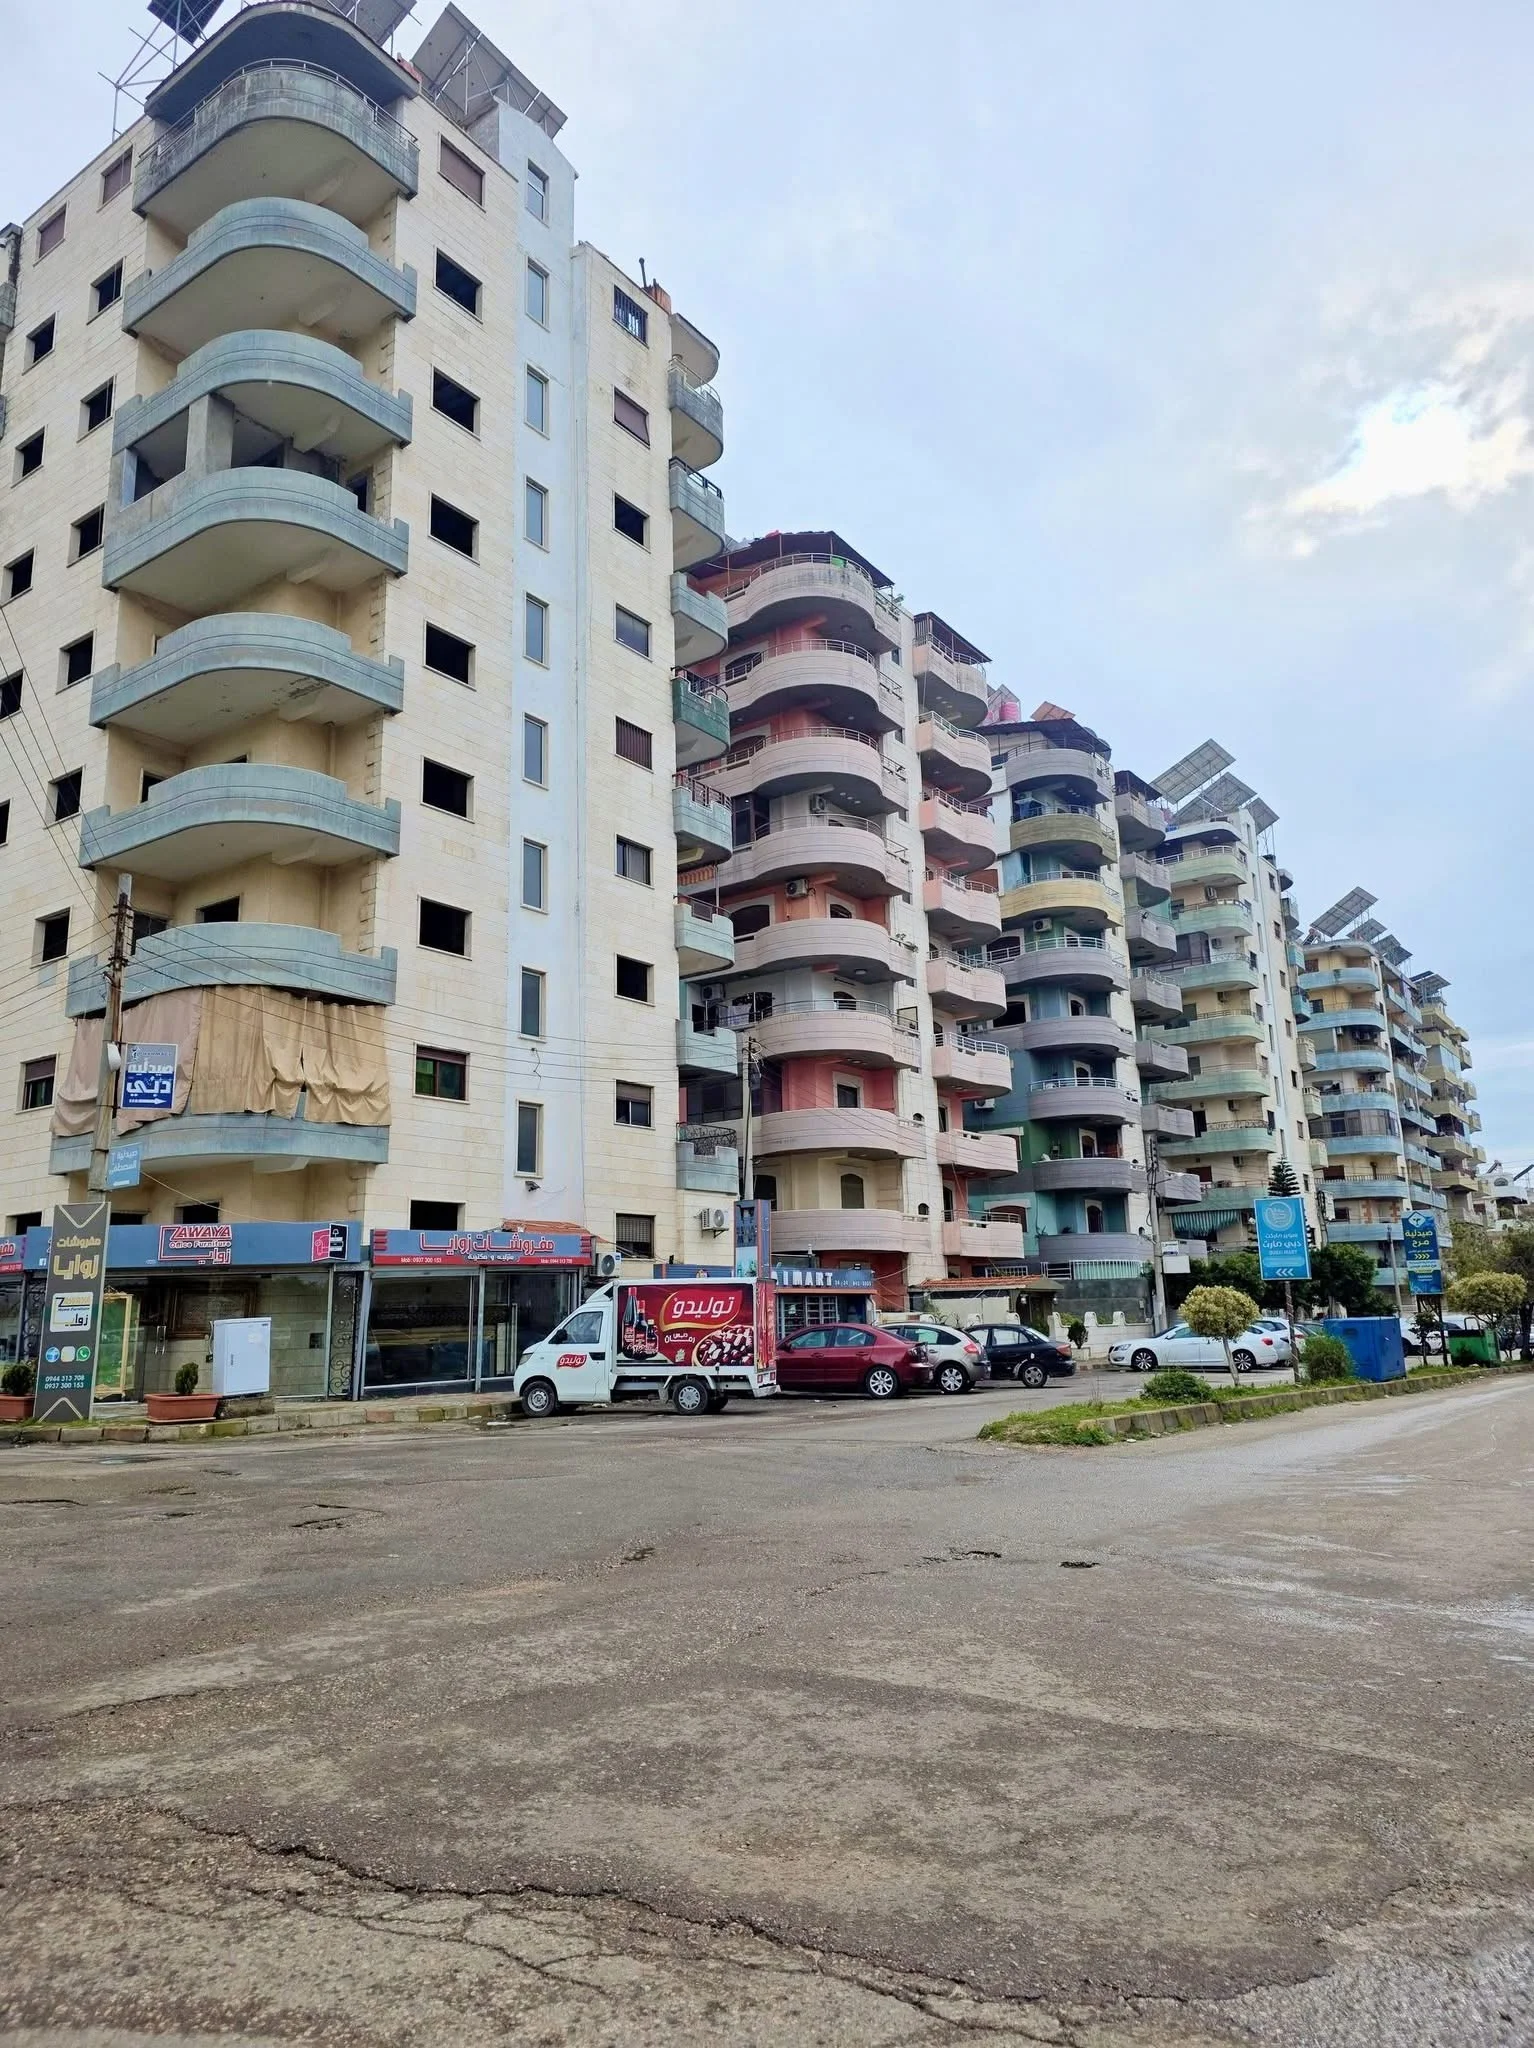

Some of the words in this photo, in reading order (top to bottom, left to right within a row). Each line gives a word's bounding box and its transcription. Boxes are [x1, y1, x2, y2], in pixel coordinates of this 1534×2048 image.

[56, 1235, 102, 1249] مفروشات
[419, 1232, 471, 1256] زوايا
[472, 1232, 555, 1255] مفروشات
[792, 1271, 833, 1286] MART
[671, 1296, 735, 1319] توليدو
